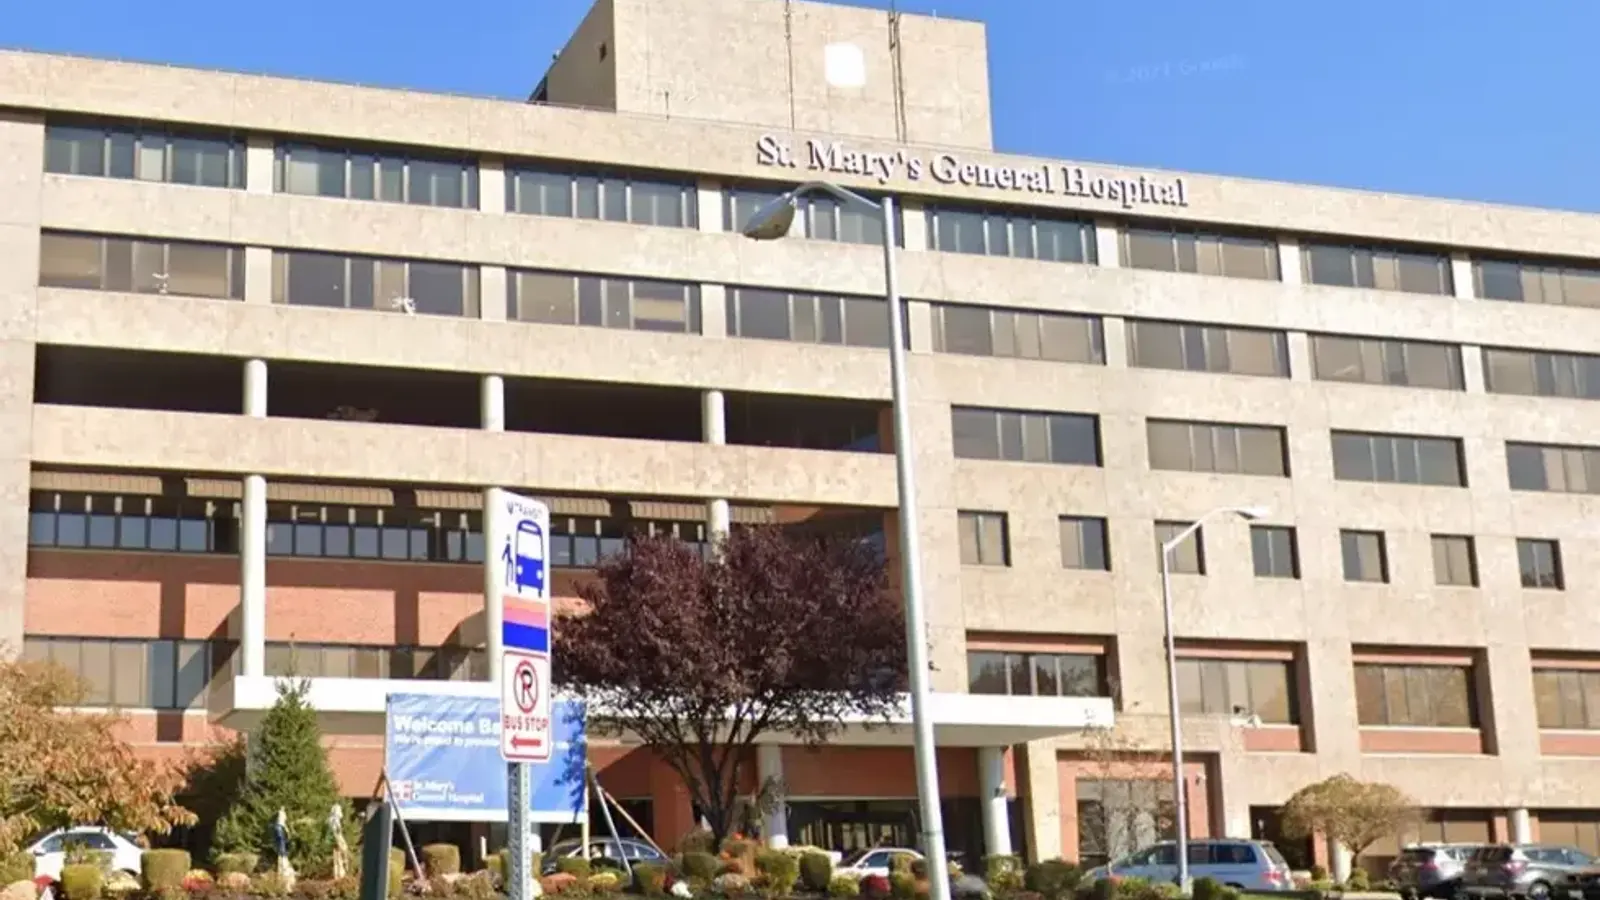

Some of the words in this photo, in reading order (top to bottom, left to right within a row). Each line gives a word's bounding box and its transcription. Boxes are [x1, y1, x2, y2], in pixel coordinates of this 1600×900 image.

[756, 134, 797, 167] St.
[808, 140, 922, 183] Mary's
[930, 154, 1054, 195] General
[1063, 166, 1190, 209] Hospital
[393, 715, 474, 733] Welcome
[504, 714, 523, 731] BUS
[525, 716, 549, 732] STOP
